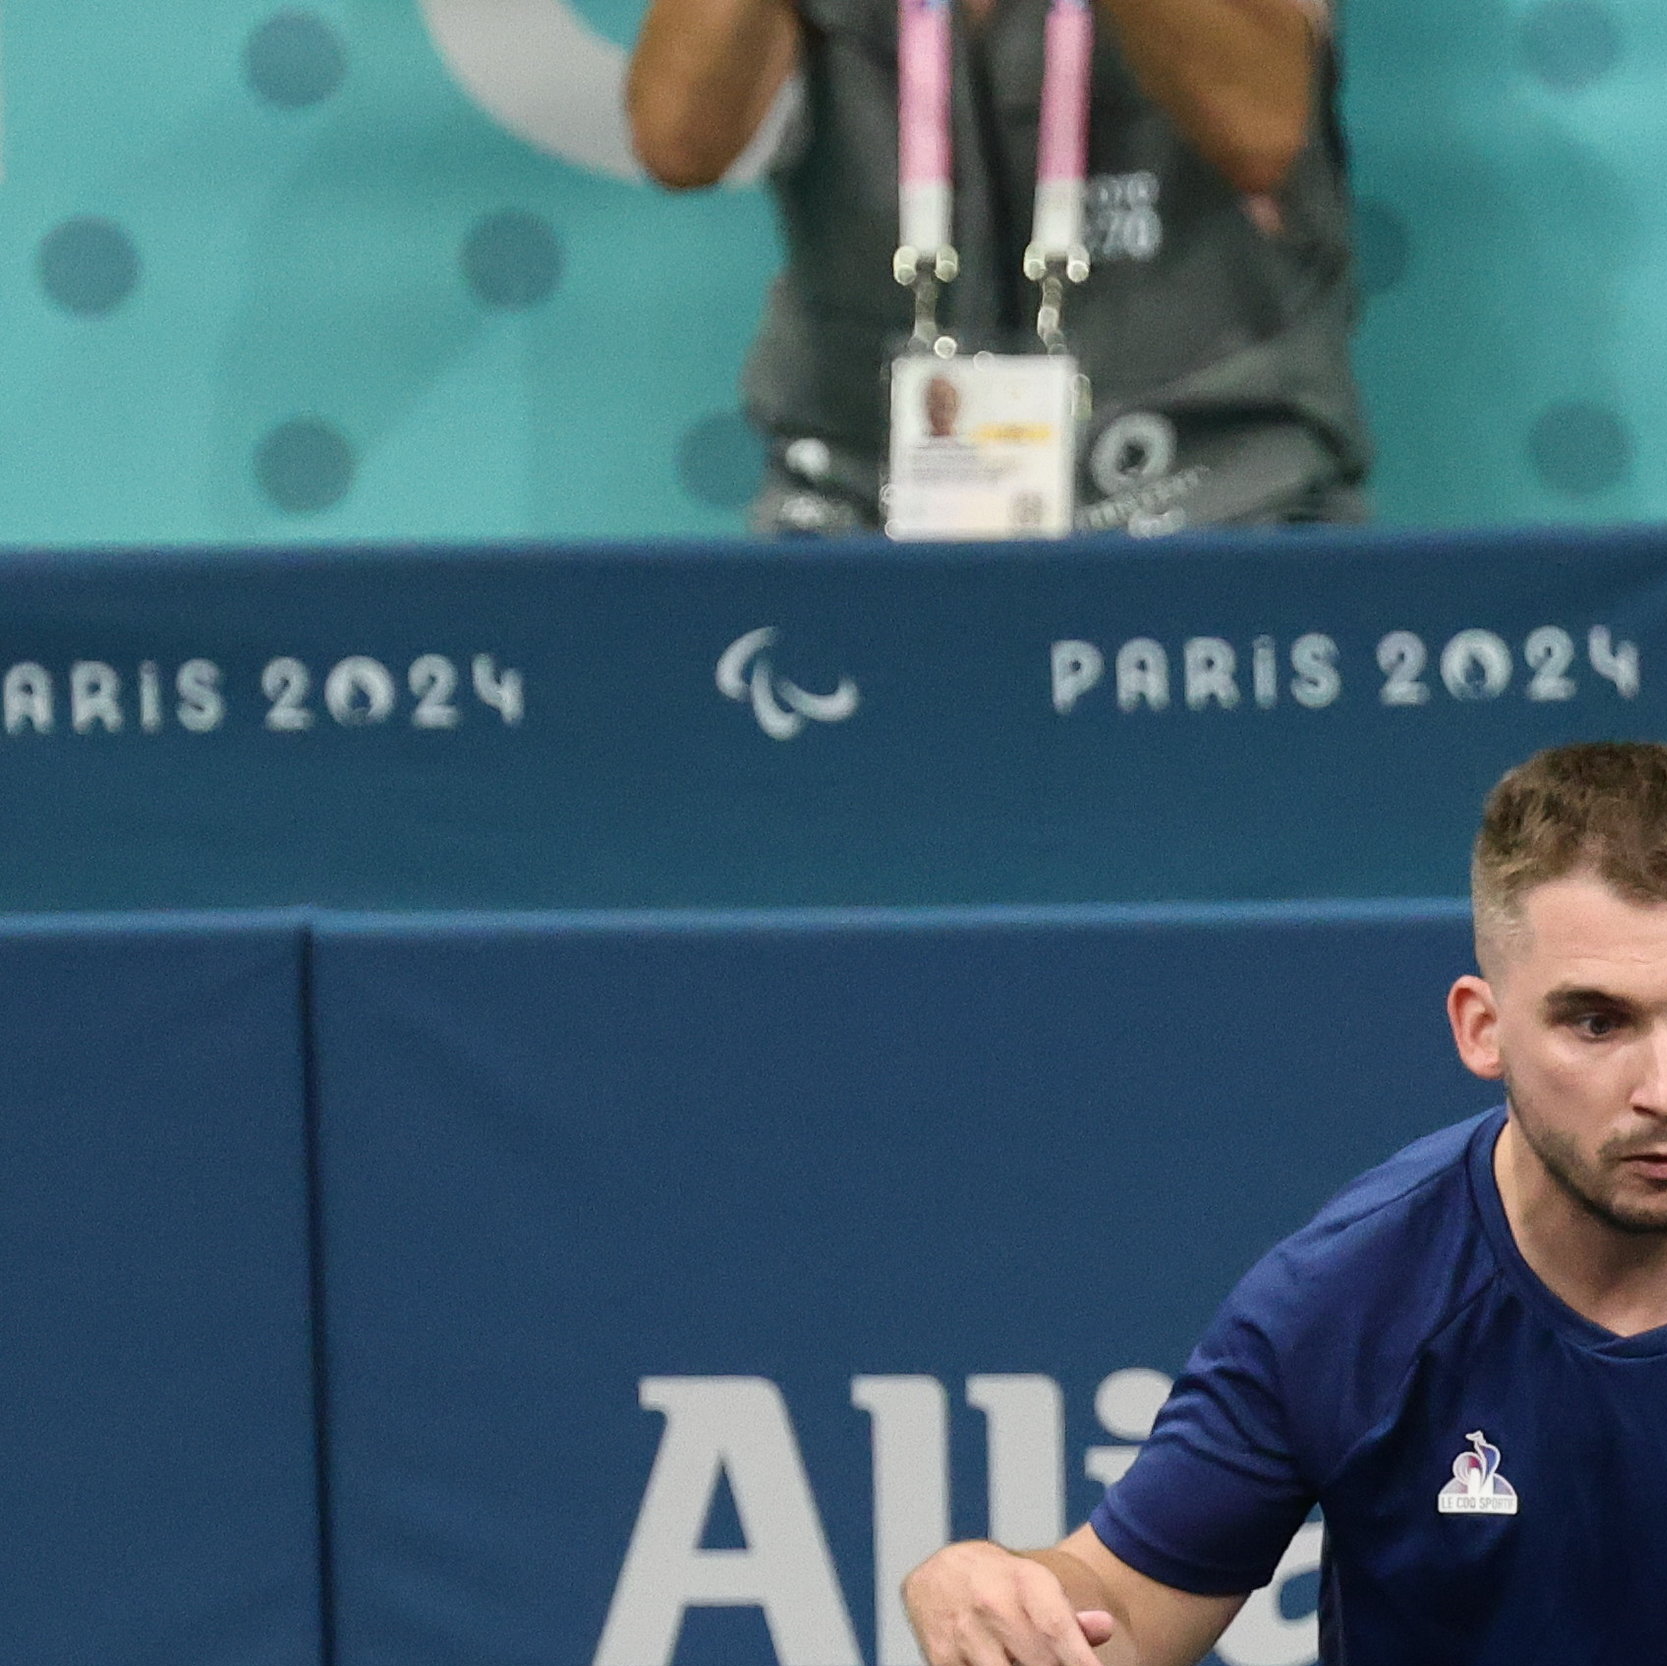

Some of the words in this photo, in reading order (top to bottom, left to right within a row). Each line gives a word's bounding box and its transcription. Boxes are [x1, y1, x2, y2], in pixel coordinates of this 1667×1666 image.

[260, 652, 524, 731] 2024
[1376, 623, 1640, 706] 2024
[1441, 1496, 1454, 1509] LE
